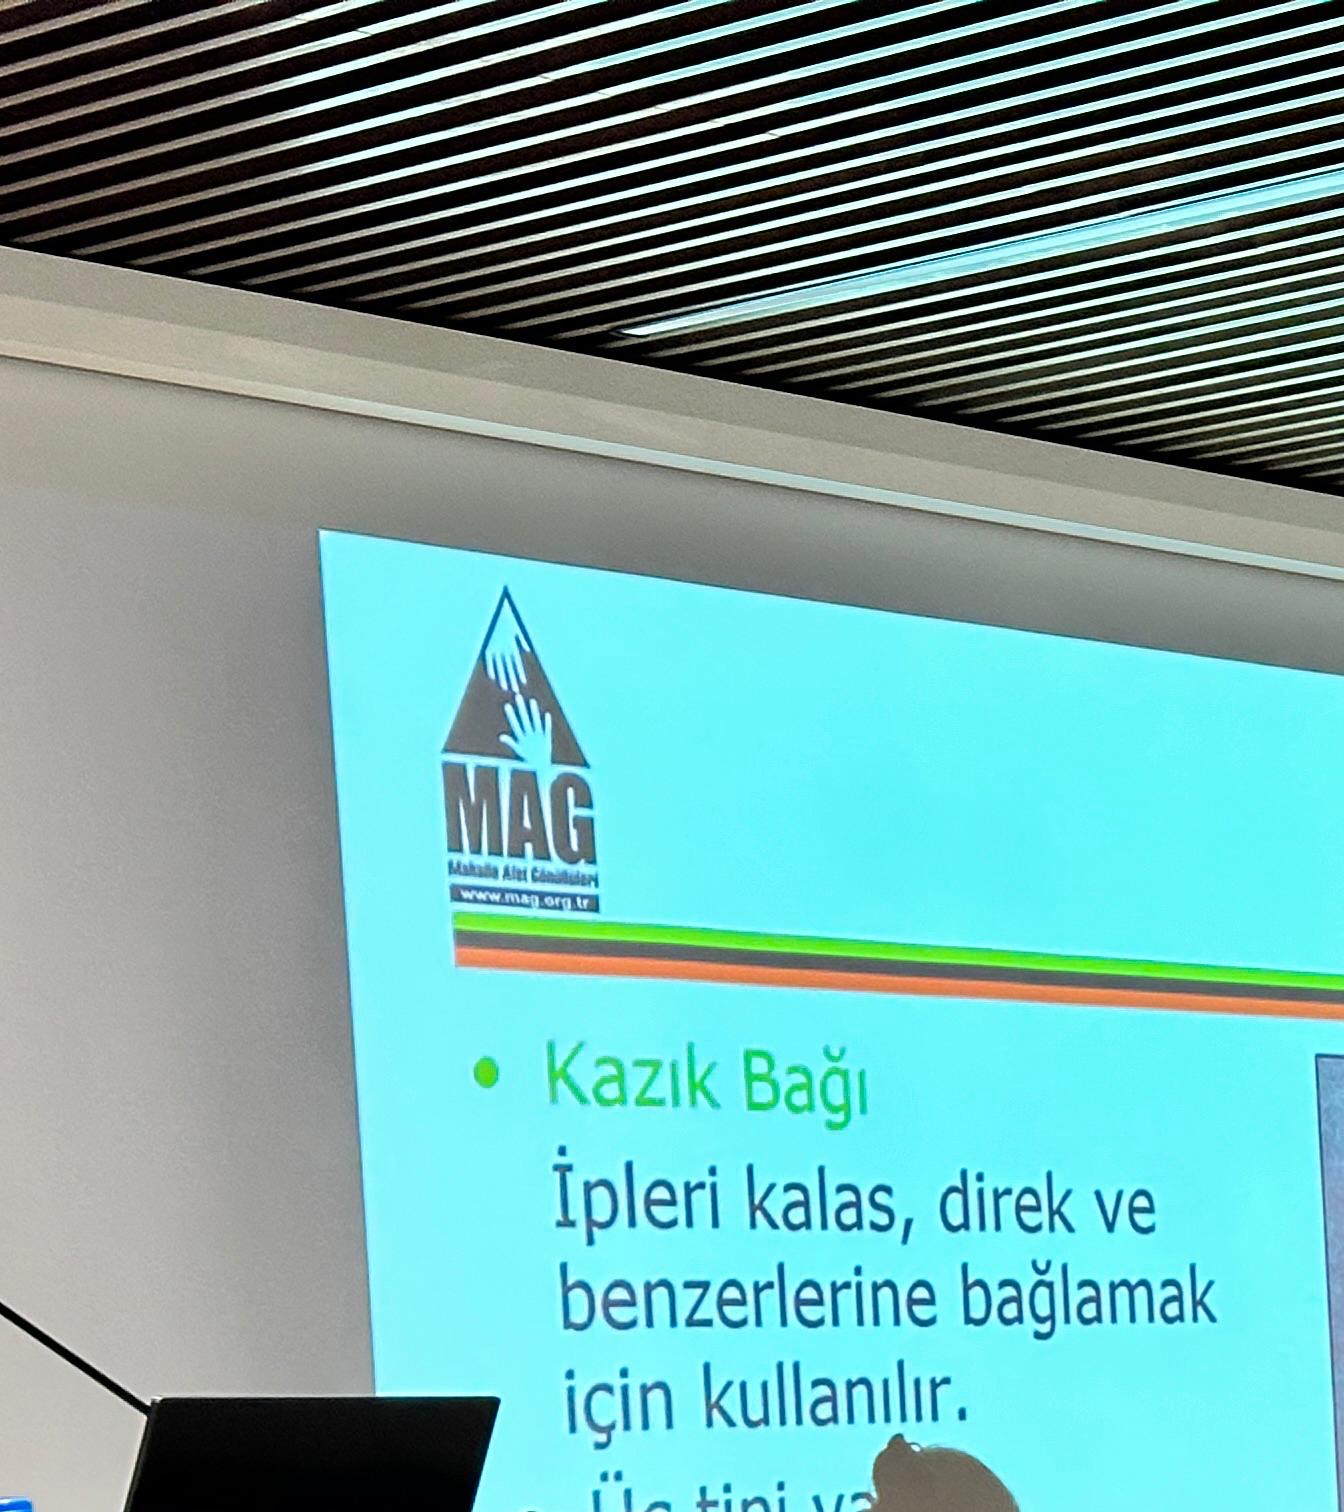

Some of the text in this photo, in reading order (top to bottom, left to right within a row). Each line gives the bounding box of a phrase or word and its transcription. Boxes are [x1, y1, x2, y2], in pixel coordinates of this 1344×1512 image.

[441, 761, 597, 865] MAG
[459, 888, 590, 909] www.mag.org.tr
[547, 1040, 869, 1130] Kazık Bağı
[553, 1145, 1157, 1247] İpleri kalas, direk ve
[559, 1259, 1218, 1339] benzerlerine bağlamak
[566, 1360, 968, 1449] için kullanılır.
